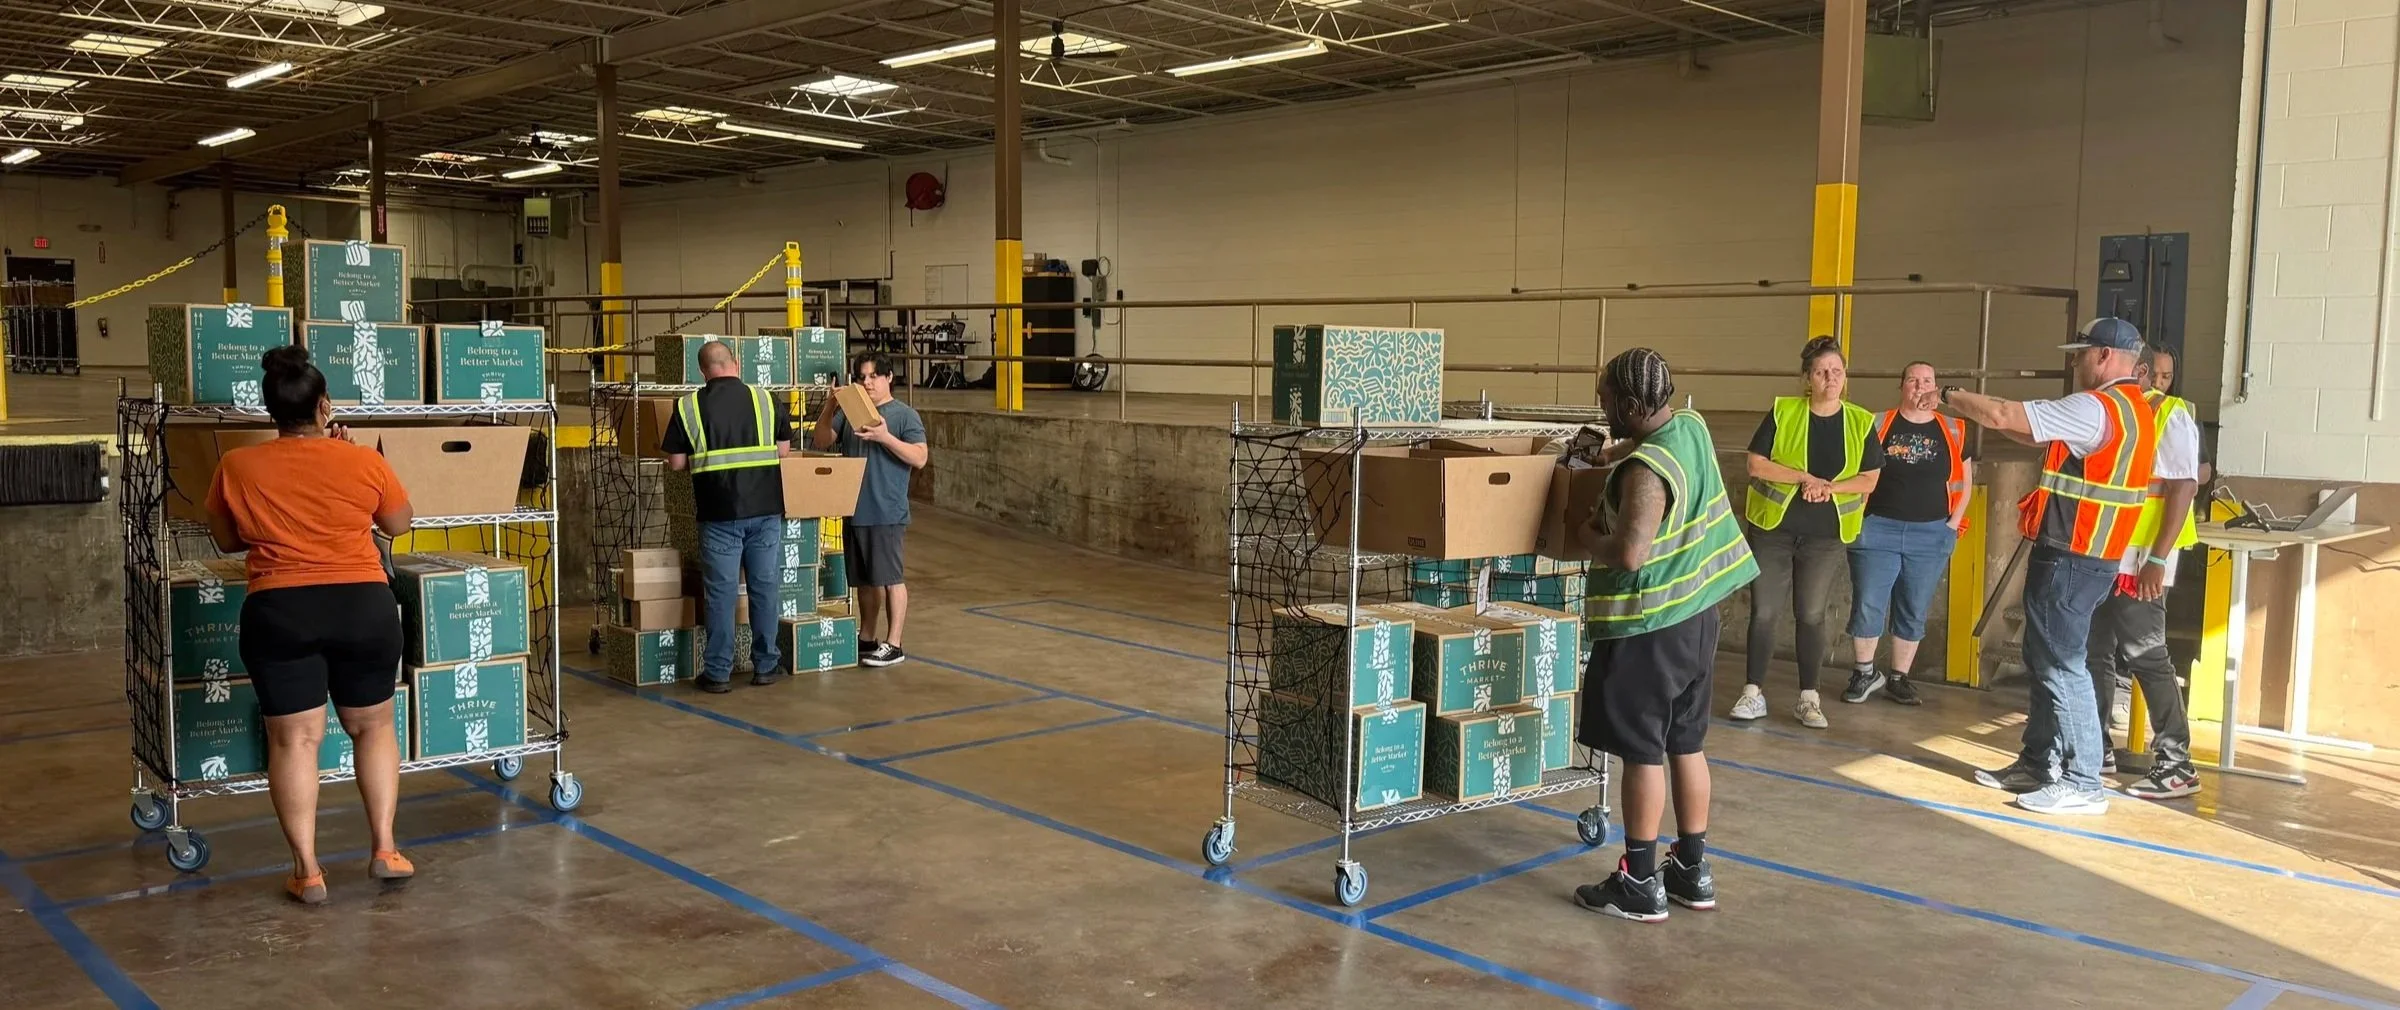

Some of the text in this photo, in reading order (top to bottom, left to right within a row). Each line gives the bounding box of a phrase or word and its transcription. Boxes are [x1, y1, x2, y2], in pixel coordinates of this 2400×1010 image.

[338, 272, 362, 280] Belong
[356, 279, 381, 287] Market
[218, 343, 248, 353] Belong
[467, 346, 499, 356] Belong
[501, 347, 510, 355] to
[211, 352, 262, 360] Better Mark
[460, 358, 524, 366] Better Market
[454, 602, 481, 611] Belong
[449, 608, 503, 620] Better Market
[185, 623, 240, 637] THRIVE
[1460, 660, 1507, 676] THRIVE
[1466, 675, 1499, 684] MARKET
[448, 700, 497, 714] THRIVE
[456, 711, 490, 720] MARKET
[196, 719, 225, 728] Belong
[190, 726, 247, 738] Better Market
[1484, 738, 1508, 749] Belong
[1509, 736, 1518, 744] to
[1388, 751, 1408, 760] Market
[1478, 746, 1526, 761] Better Market
